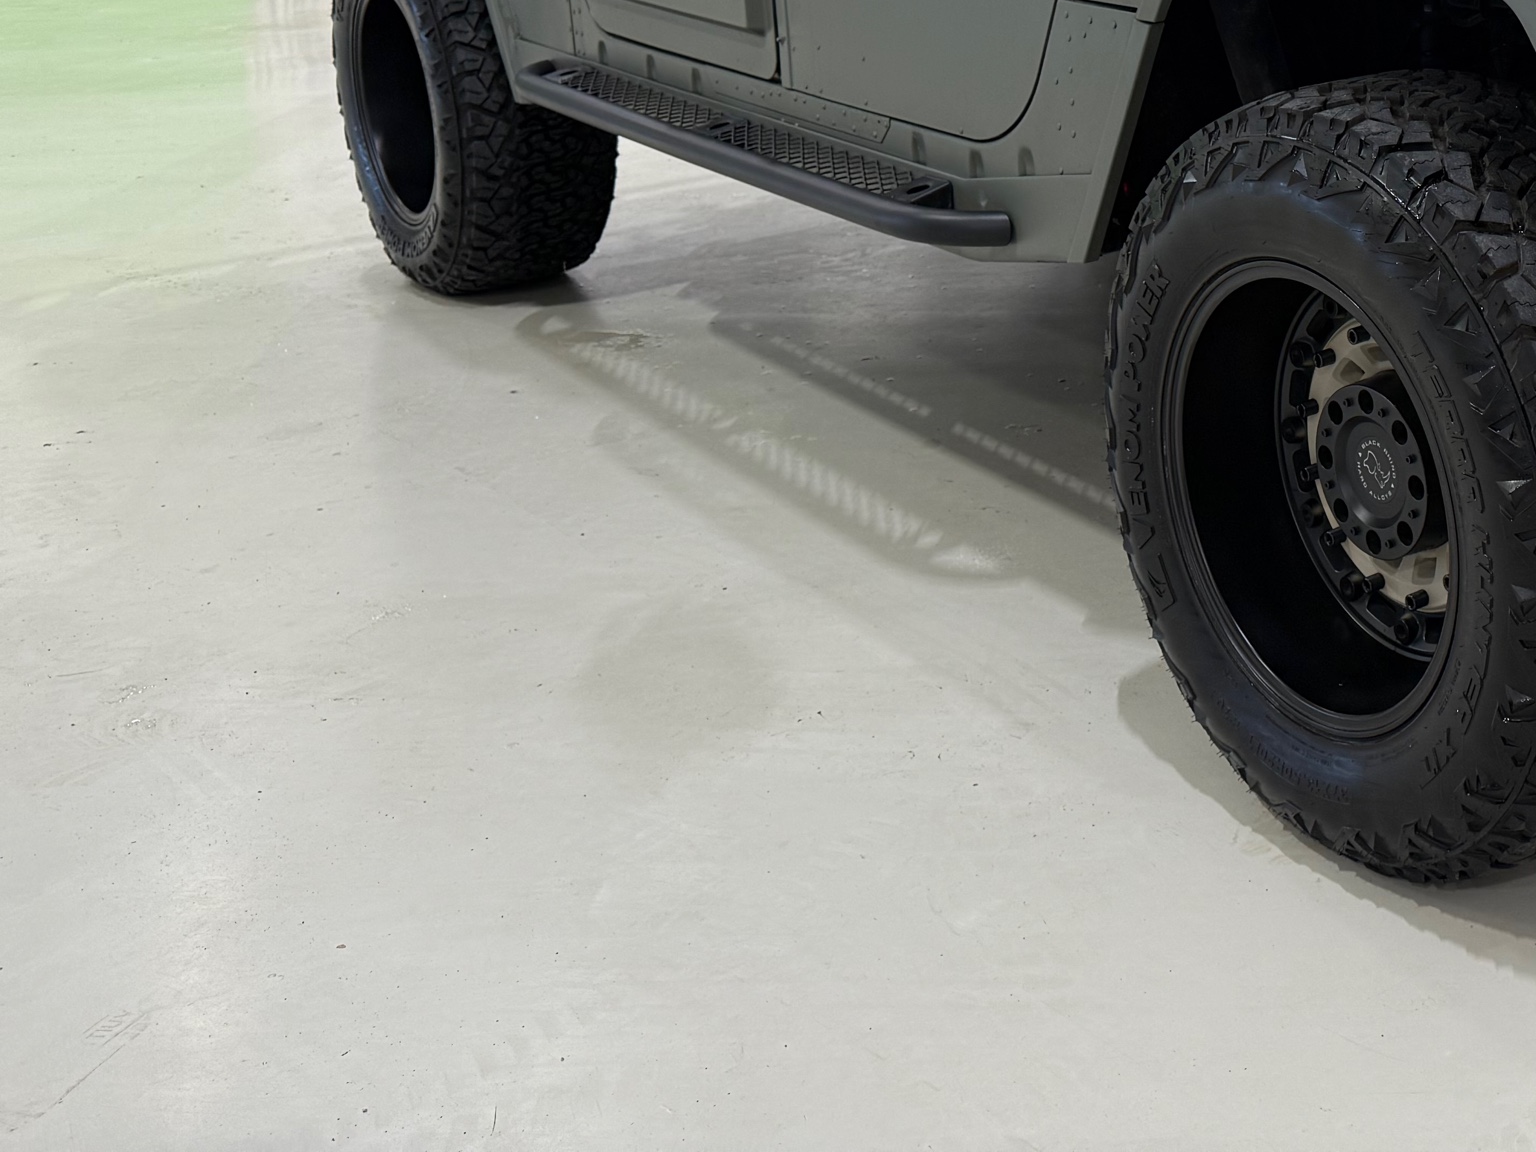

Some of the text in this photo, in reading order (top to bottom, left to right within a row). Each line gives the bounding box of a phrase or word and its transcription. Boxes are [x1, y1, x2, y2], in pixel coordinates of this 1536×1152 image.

[1121, 258, 1171, 550] VENOM POWER
[1361, 440, 1397, 479] BLACK RHINO
[1369, 490, 1393, 501] ALLOYS
